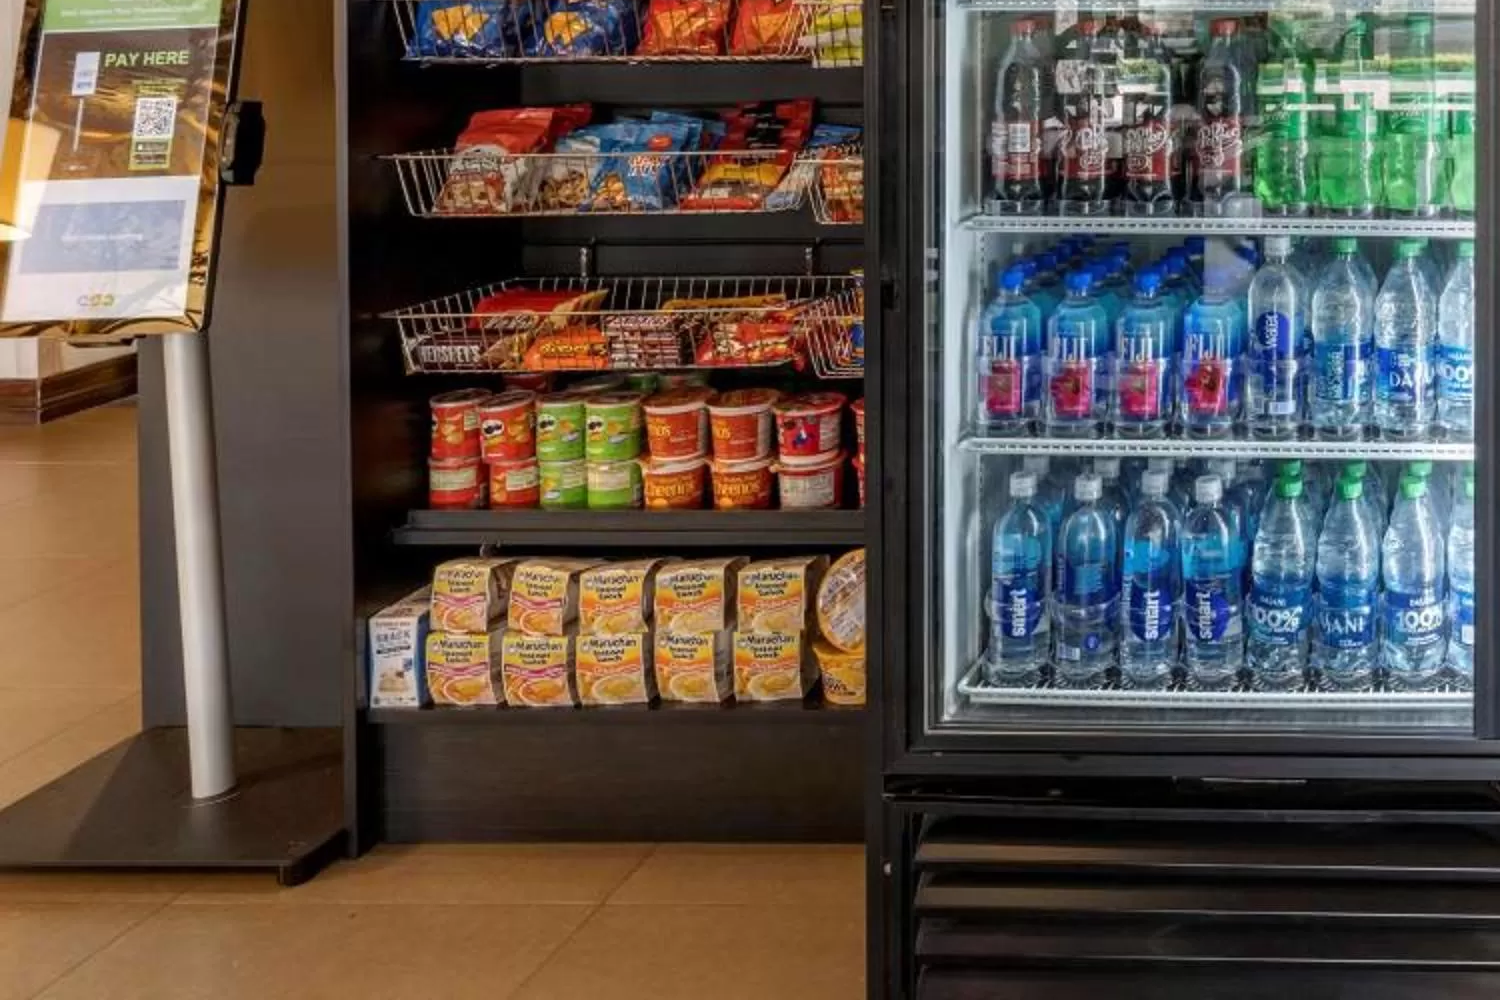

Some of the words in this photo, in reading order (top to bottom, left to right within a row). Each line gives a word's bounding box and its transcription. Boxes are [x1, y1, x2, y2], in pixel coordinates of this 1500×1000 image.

[105, 53, 140, 68] PAY
[143, 50, 191, 66] HERE
[1011, 588, 1027, 637] smart
[1144, 590, 1160, 640] smart
[1196, 592, 1213, 640] smart
